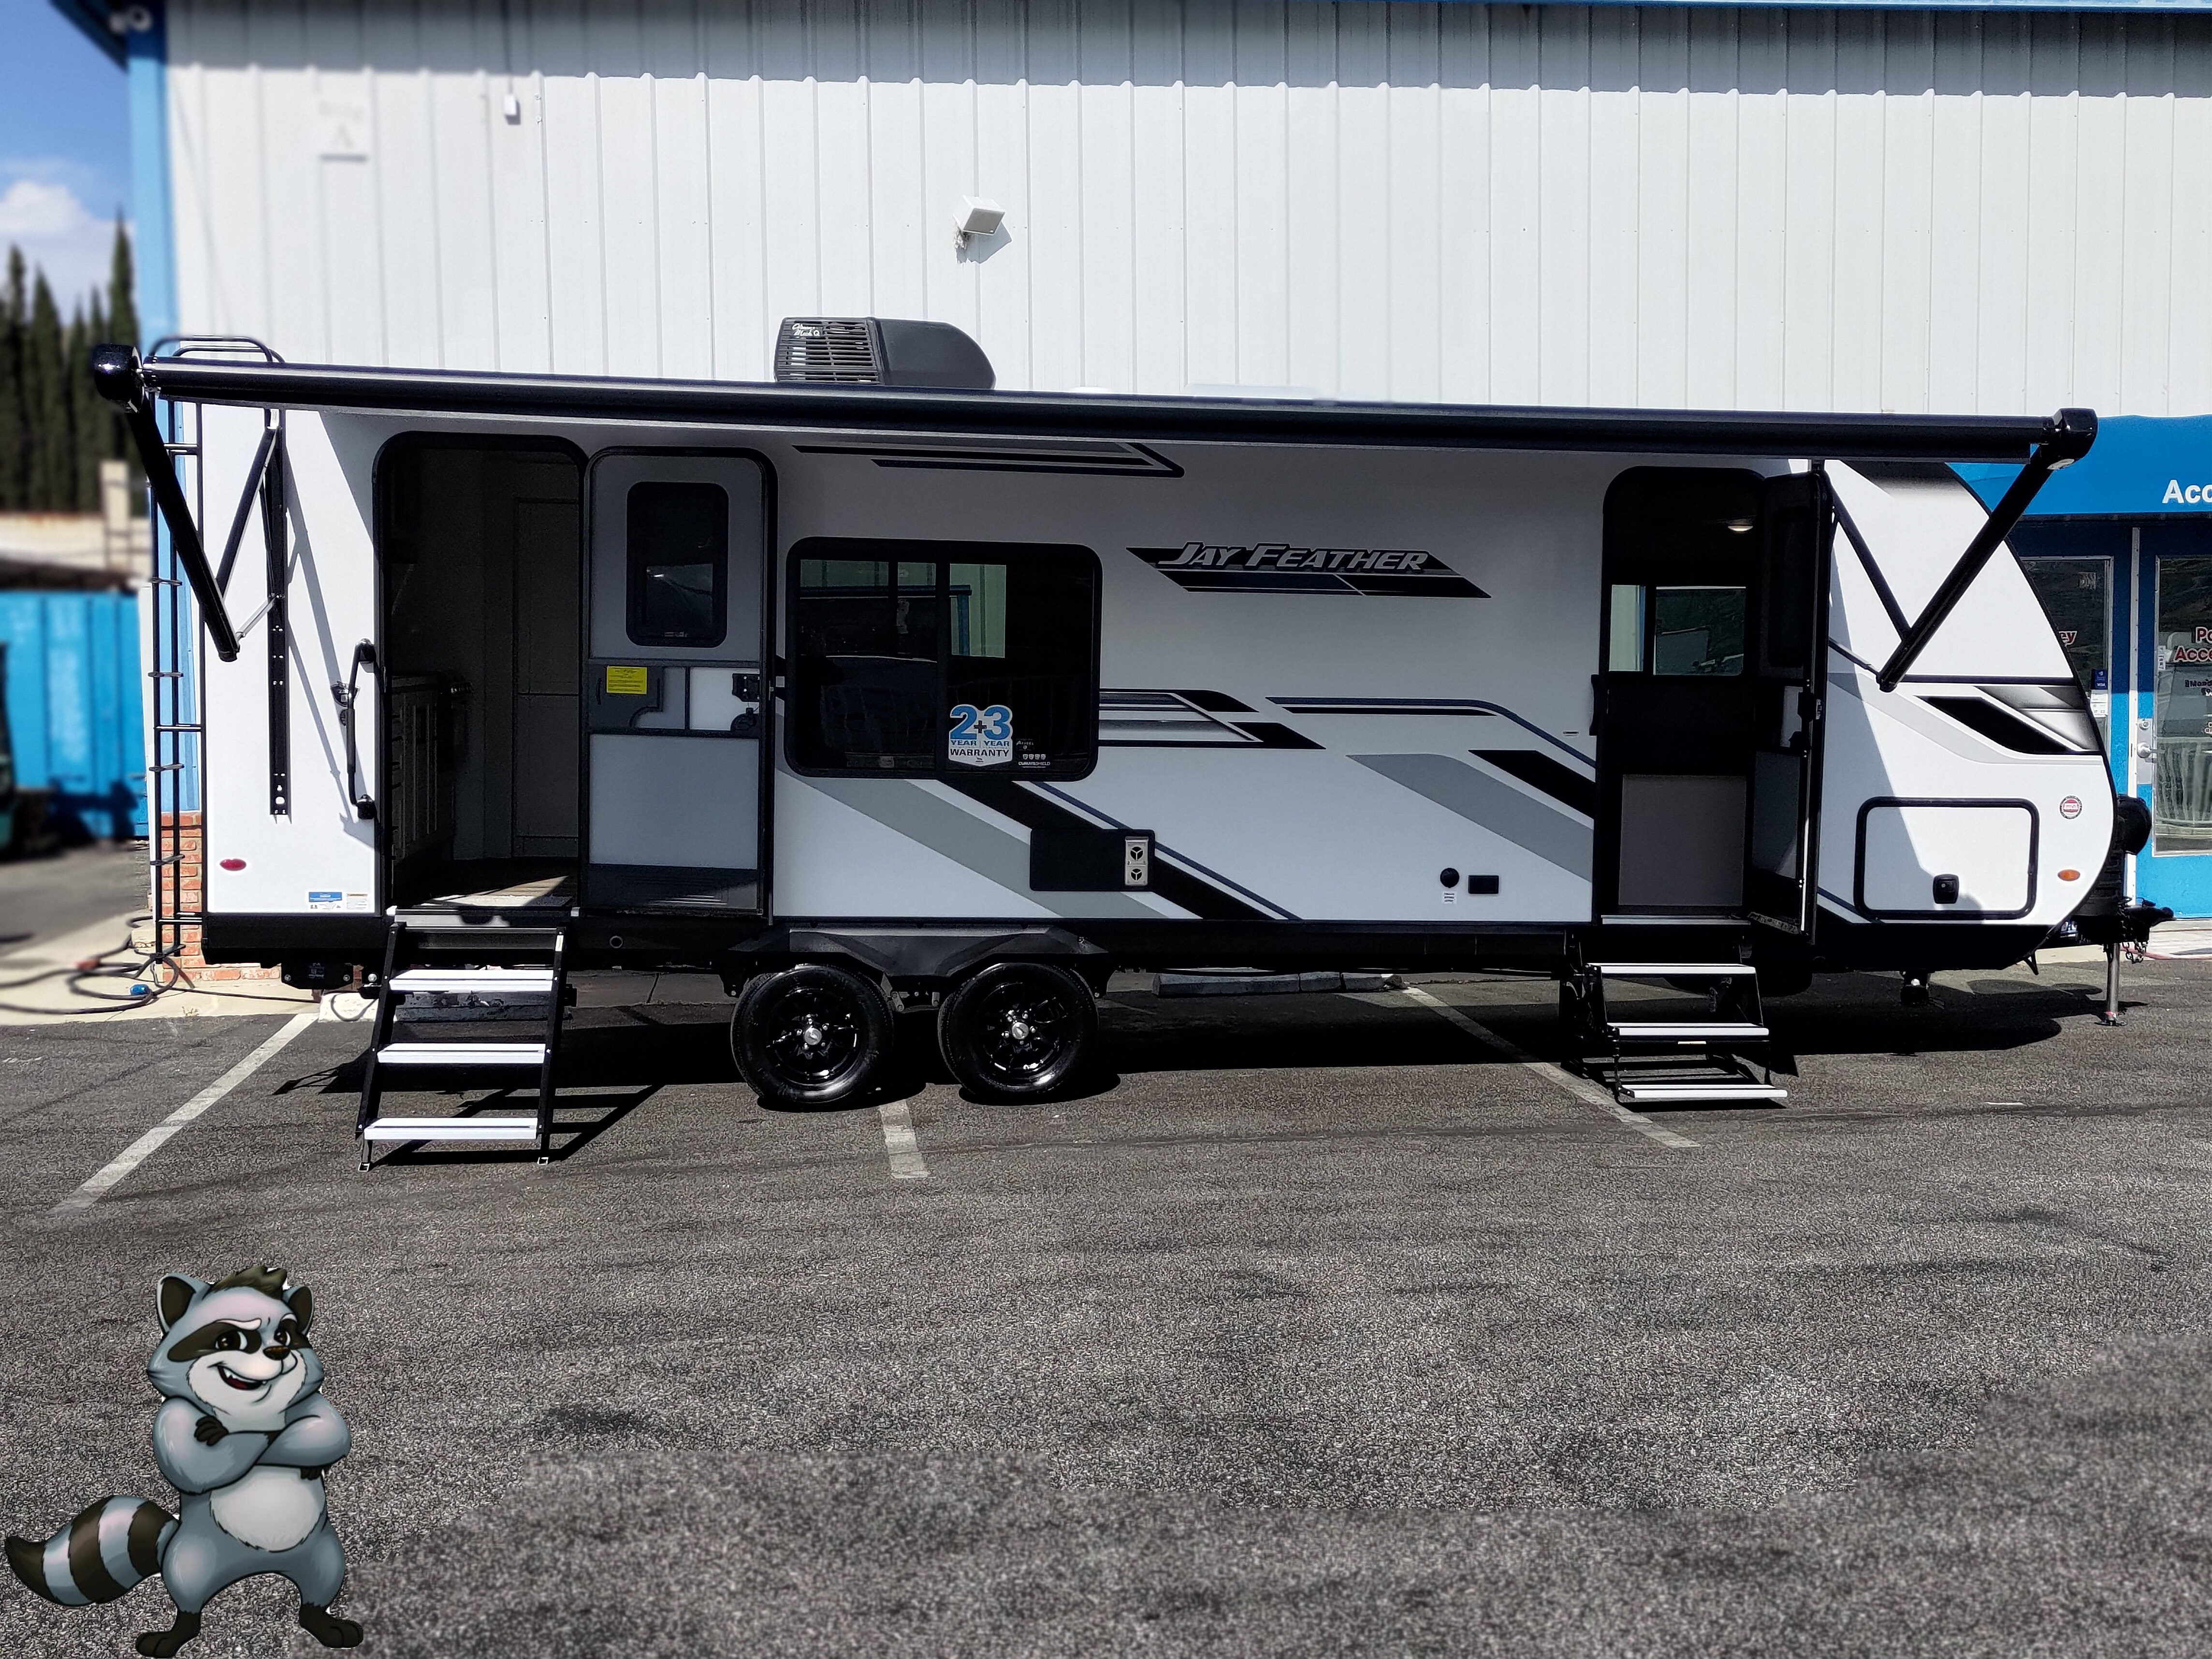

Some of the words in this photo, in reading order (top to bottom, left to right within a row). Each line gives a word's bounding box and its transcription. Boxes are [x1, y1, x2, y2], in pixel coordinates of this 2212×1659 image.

[1159, 542, 1242, 566] JAY
[1246, 544, 1428, 571] FEATHER
[950, 748, 1009, 757] WARRANTY
